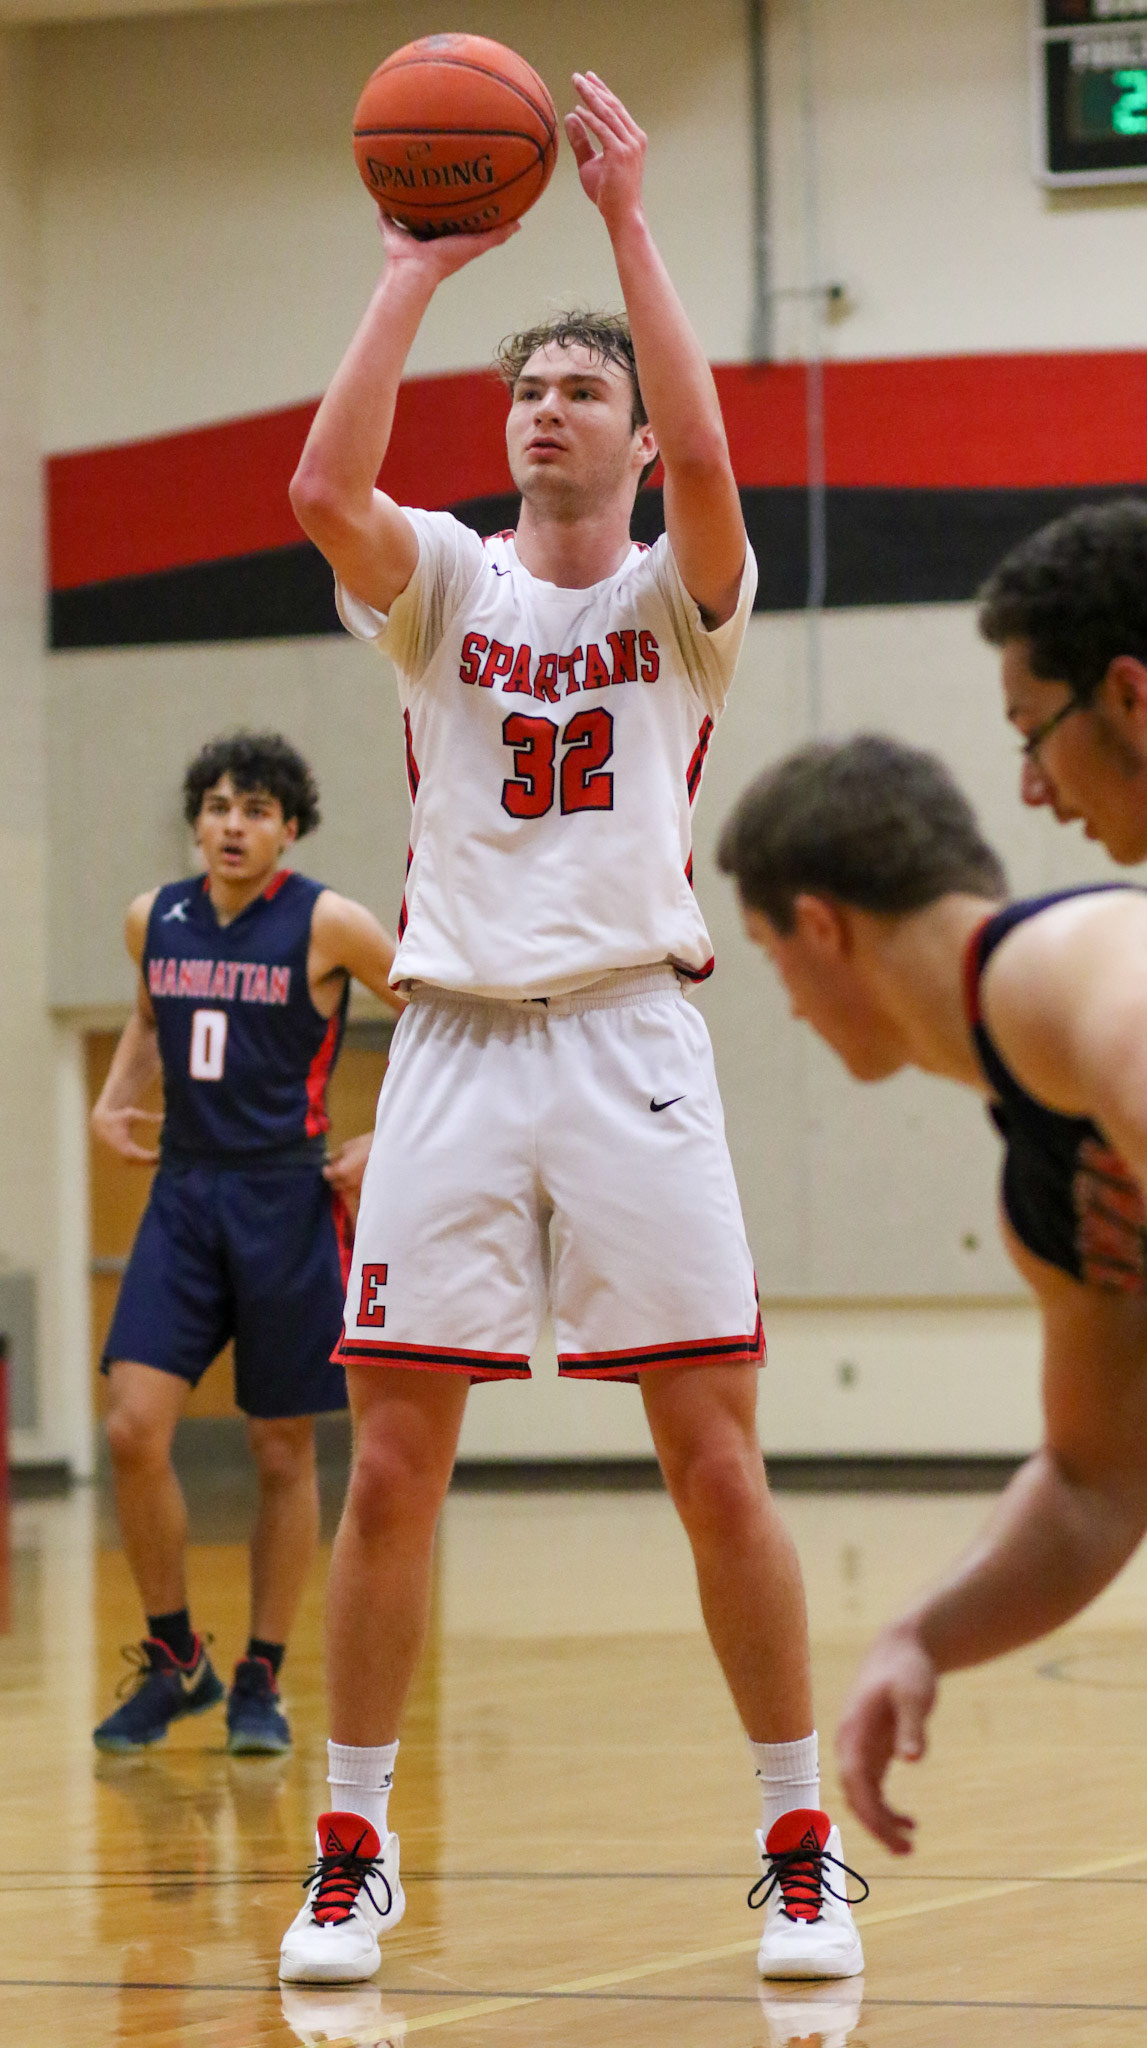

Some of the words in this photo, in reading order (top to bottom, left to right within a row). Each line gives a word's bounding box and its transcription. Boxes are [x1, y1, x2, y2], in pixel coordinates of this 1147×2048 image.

[1112, 69, 1147, 135] 2
[366, 153, 493, 188] SPALDING
[459, 629, 660, 703] SPARTANS
[501, 706, 614, 819] 32
[149, 957, 291, 1006] MANHATTAN
[189, 1009, 228, 1081] 0
[356, 1263, 388, 1328] E
